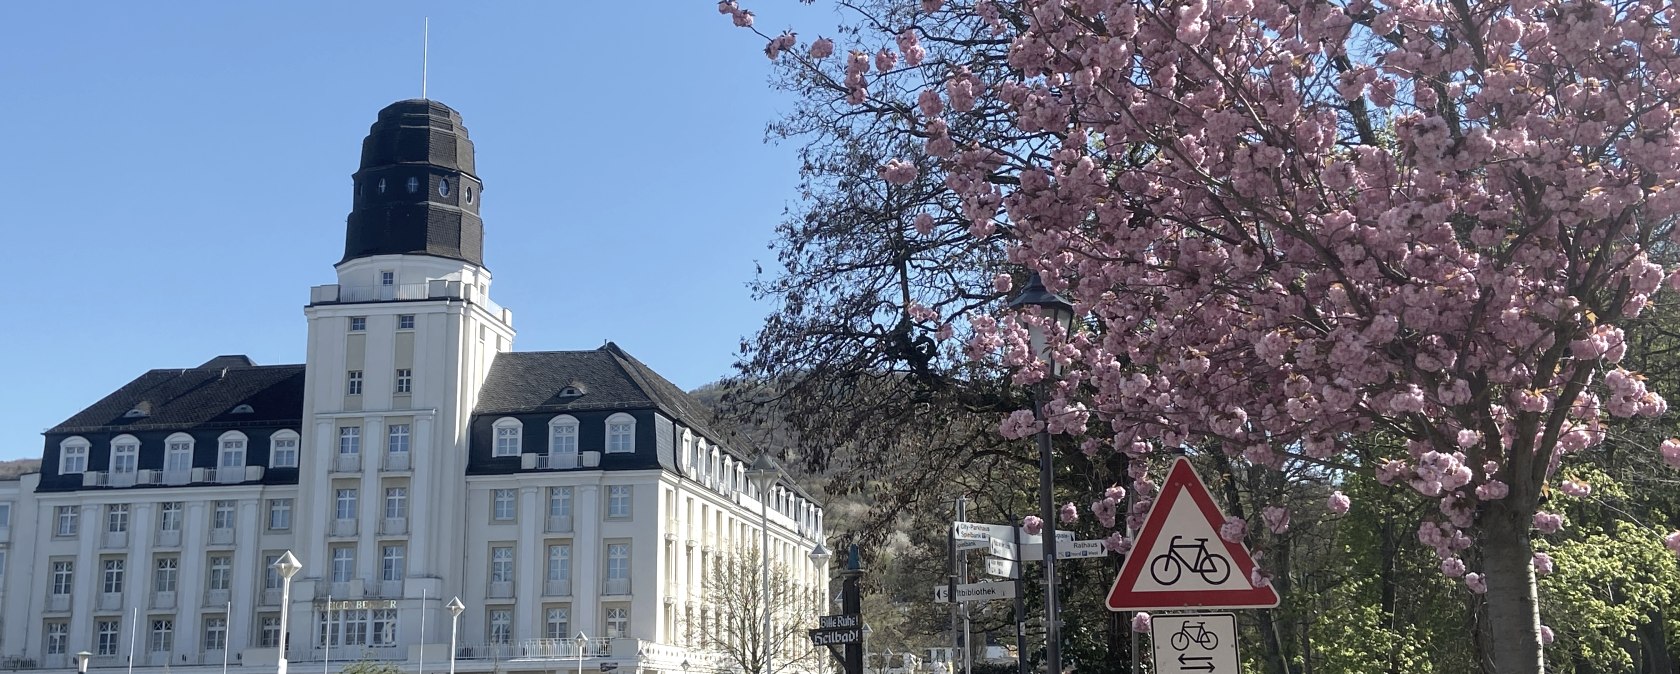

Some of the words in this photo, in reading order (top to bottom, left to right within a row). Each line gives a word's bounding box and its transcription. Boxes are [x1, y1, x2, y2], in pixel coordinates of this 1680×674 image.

[960, 523, 990, 532] City-Parkhaus
[960, 531, 981, 539] Spielbank
[943, 587, 996, 599] Stbibliothek
[837, 615, 859, 629] Ruhe!
[814, 630, 859, 645] Heilbad!
